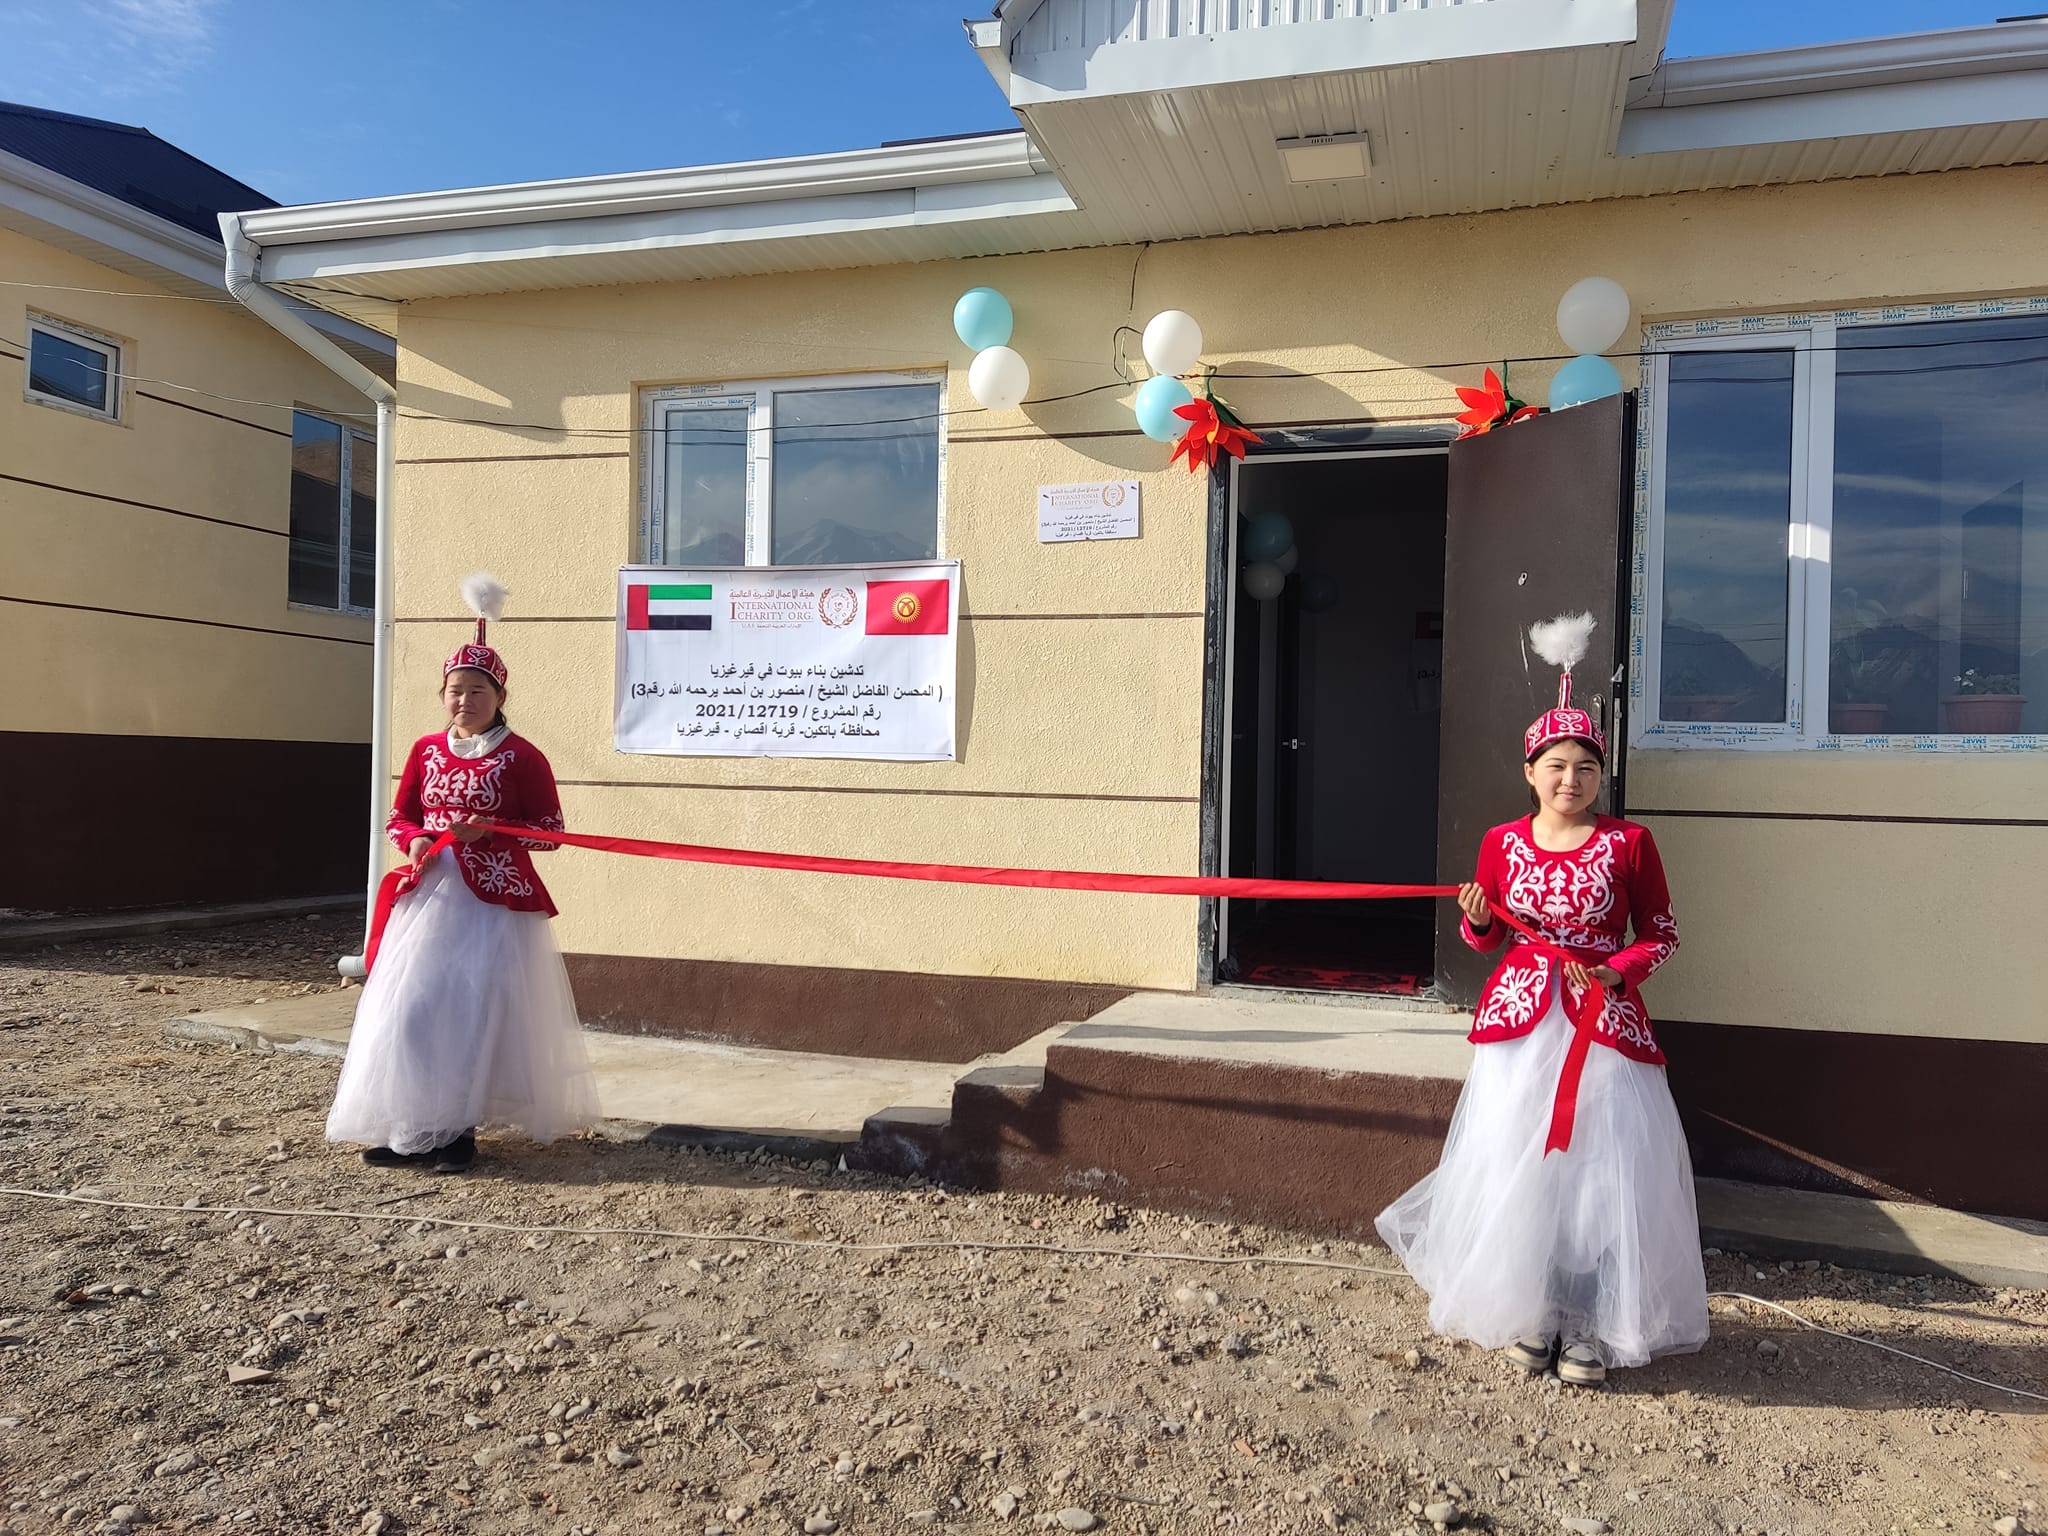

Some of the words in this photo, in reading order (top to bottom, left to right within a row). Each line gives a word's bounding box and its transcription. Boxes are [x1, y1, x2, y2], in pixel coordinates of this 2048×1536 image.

[1930, 304, 1955, 312] SMART
[1979, 306, 2004, 314] SMART
[1696, 325, 1719, 333] SMART
[738, 612, 783, 620] CHARITY
[710, 663, 754, 679] قيرغيزيا
[758, 663, 773, 680] في
[776, 666, 802, 678] بيوت
[807, 665, 826, 678] بناء
[830, 664, 864, 678] تدشين
[668, 680, 682, 695] الله
[686, 684, 719, 698] يرحمه
[722, 681, 746, 695] أحمد
[750, 686, 764, 698] بن
[768, 684, 805, 699] منصور
[817, 684, 848, 701] الشيخ
[852, 684, 889, 699] الفاضل
[893, 685, 934, 700] المحسن
[811, 705, 858, 721] المشروع
[862, 703, 881, 721] رقم
[677, 722, 720, 737] قيرغيزيا
[772, 722, 795, 738] قرية
[840, 723, 880, 736] محافظة
